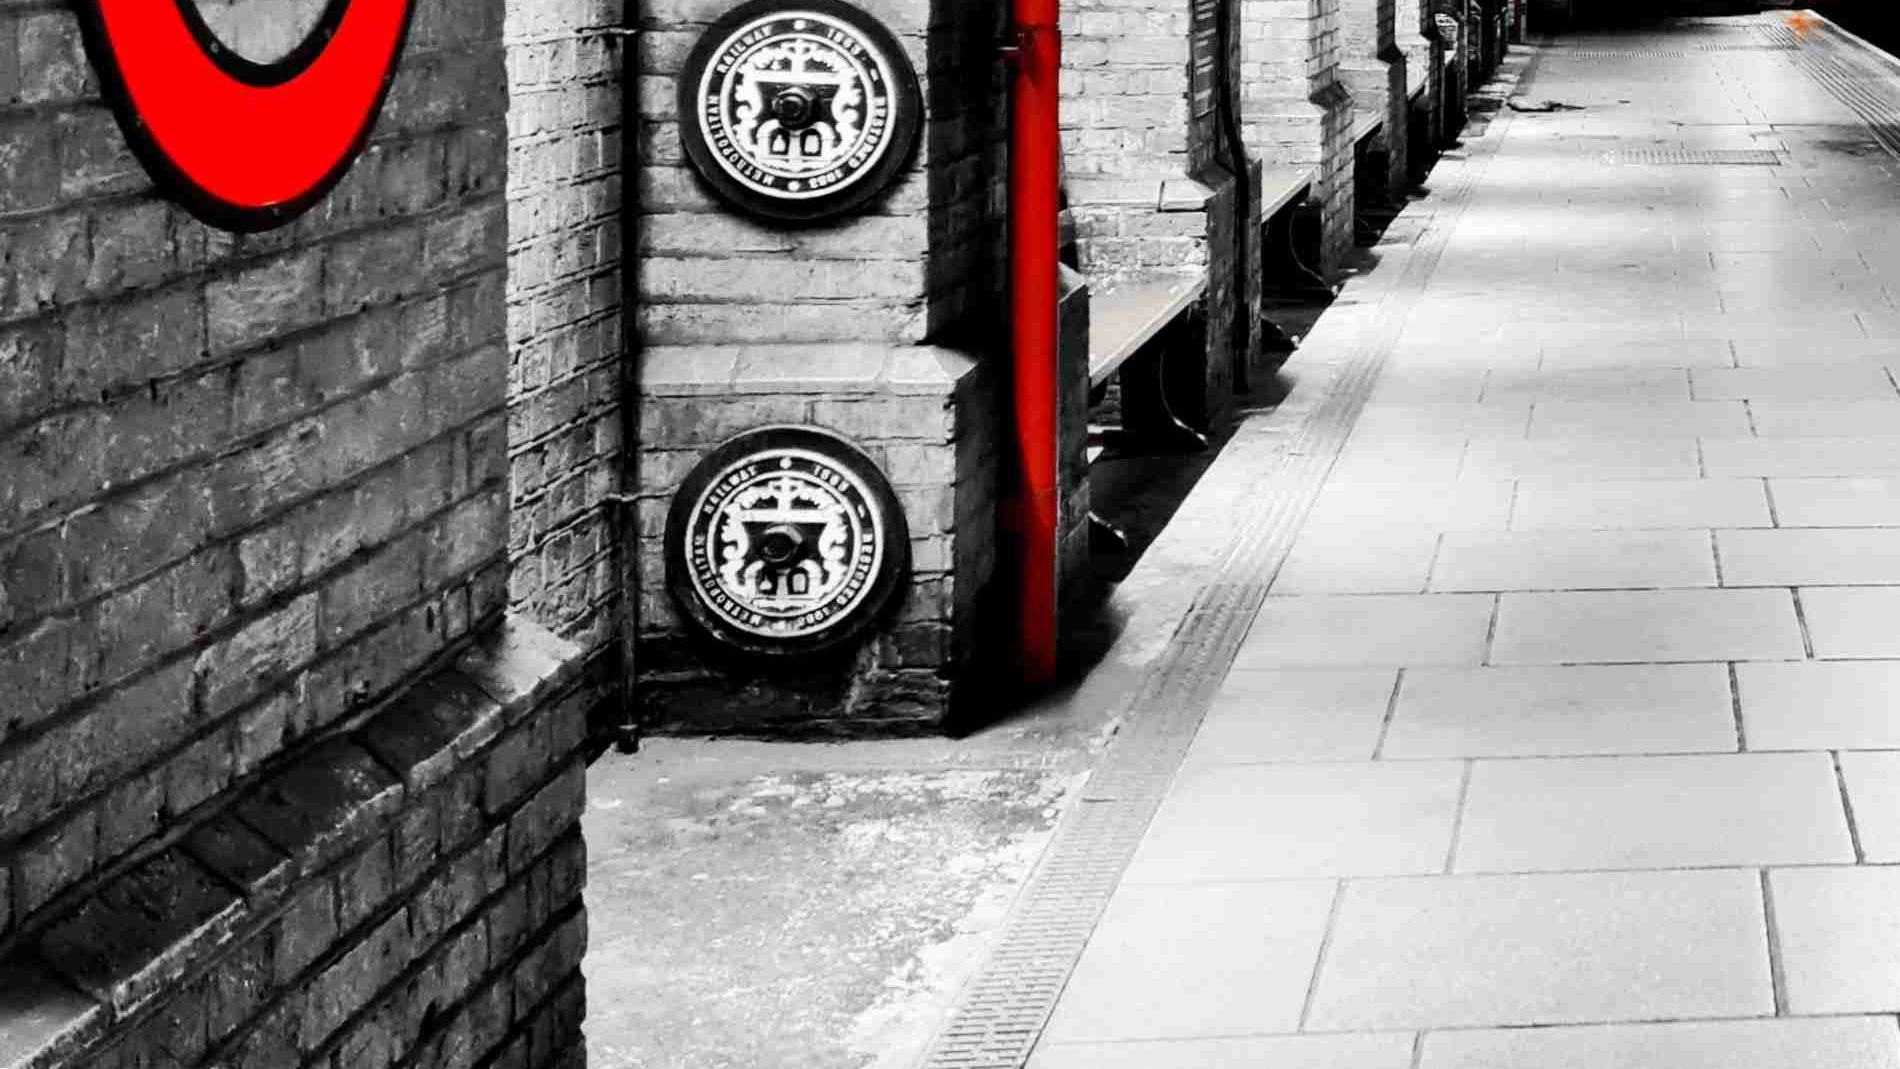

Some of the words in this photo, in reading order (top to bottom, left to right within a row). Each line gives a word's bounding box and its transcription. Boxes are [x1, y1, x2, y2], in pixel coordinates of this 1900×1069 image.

[716, 26, 773, 75] RAILWAY
[707, 94, 775, 186] METROPOLITAN
[848, 95, 887, 169] RESTORED
